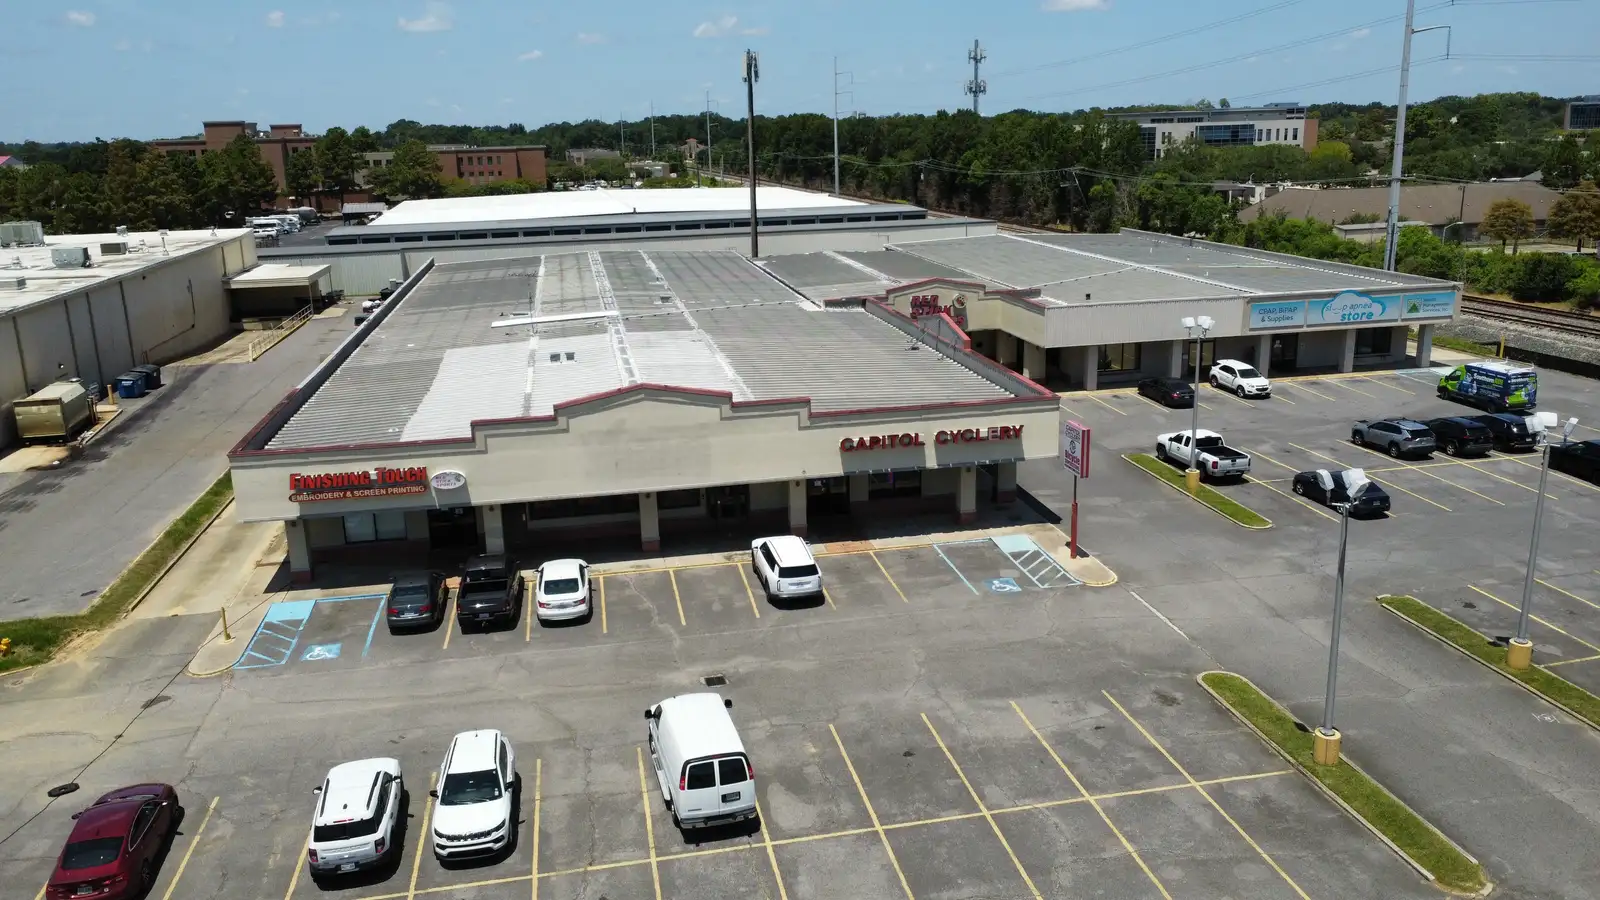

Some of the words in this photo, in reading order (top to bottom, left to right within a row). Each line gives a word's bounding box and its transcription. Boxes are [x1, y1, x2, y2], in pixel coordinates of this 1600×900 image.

[911, 295, 939, 306] RED
[1349, 302, 1373, 311] apnea
[1267, 314, 1294, 323] Supplies
[1340, 311, 1374, 321] store
[840, 432, 925, 453] CAPITOL
[935, 424, 1025, 445] CYCLERY
[289, 470, 370, 491] FINISHING
[374, 466, 427, 485] TOUCH
[291, 490, 344, 502] EMBROIDERY
[347, 490, 352, 498] &
[353, 488, 386, 498] SCREEN
[387, 485, 425, 495] PRINTING
